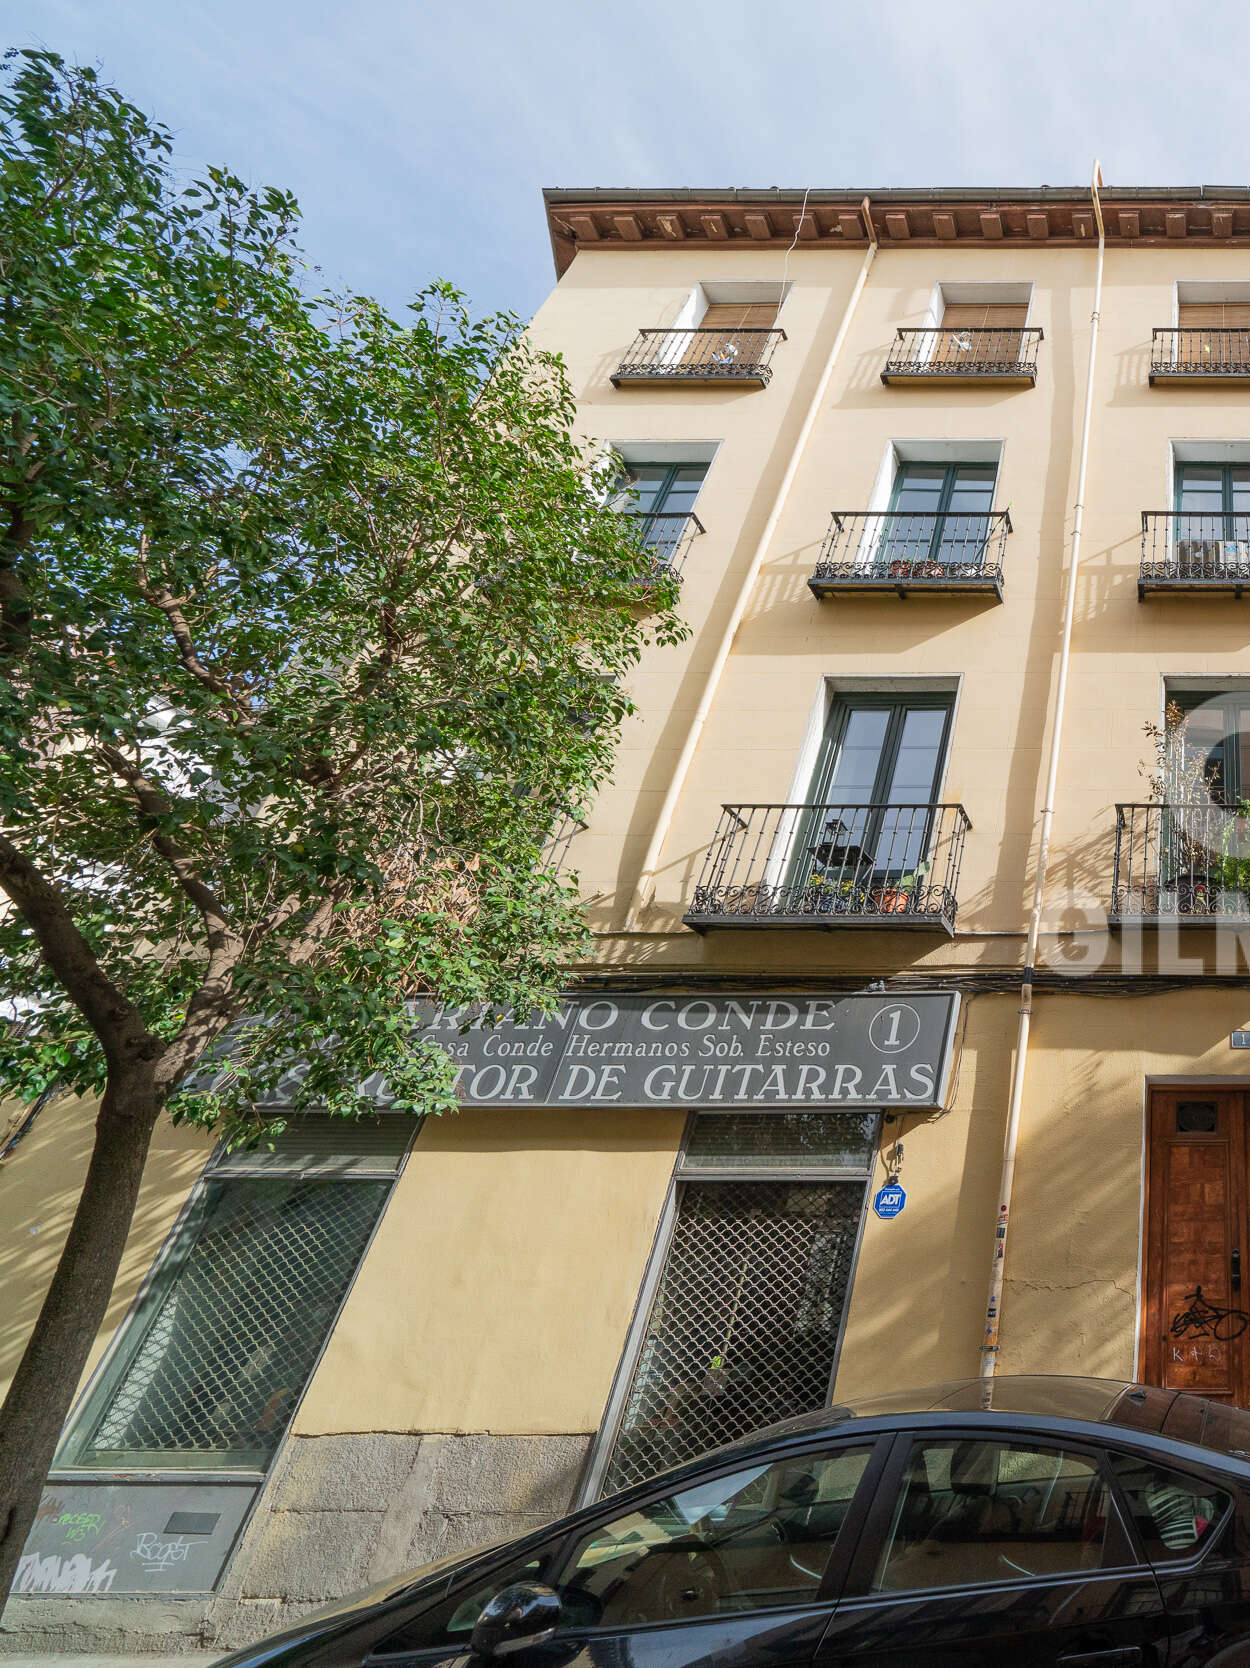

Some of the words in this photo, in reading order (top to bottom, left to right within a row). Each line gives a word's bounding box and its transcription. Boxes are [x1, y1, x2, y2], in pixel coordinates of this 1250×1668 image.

[641, 1000, 836, 1031] CONDE
[883, 1009, 902, 1046] 1
[483, 1034, 554, 1057] Conde
[565, 1034, 690, 1057] Hermanos
[699, 1034, 744, 1057] Sob.
[755, 1034, 831, 1057] Esteso
[1240, 1033, 1247, 1045] 1
[558, 1063, 627, 1100] DE
[643, 1063, 935, 1101] GUITARRAS
[880, 1193, 902, 1205] ADT
